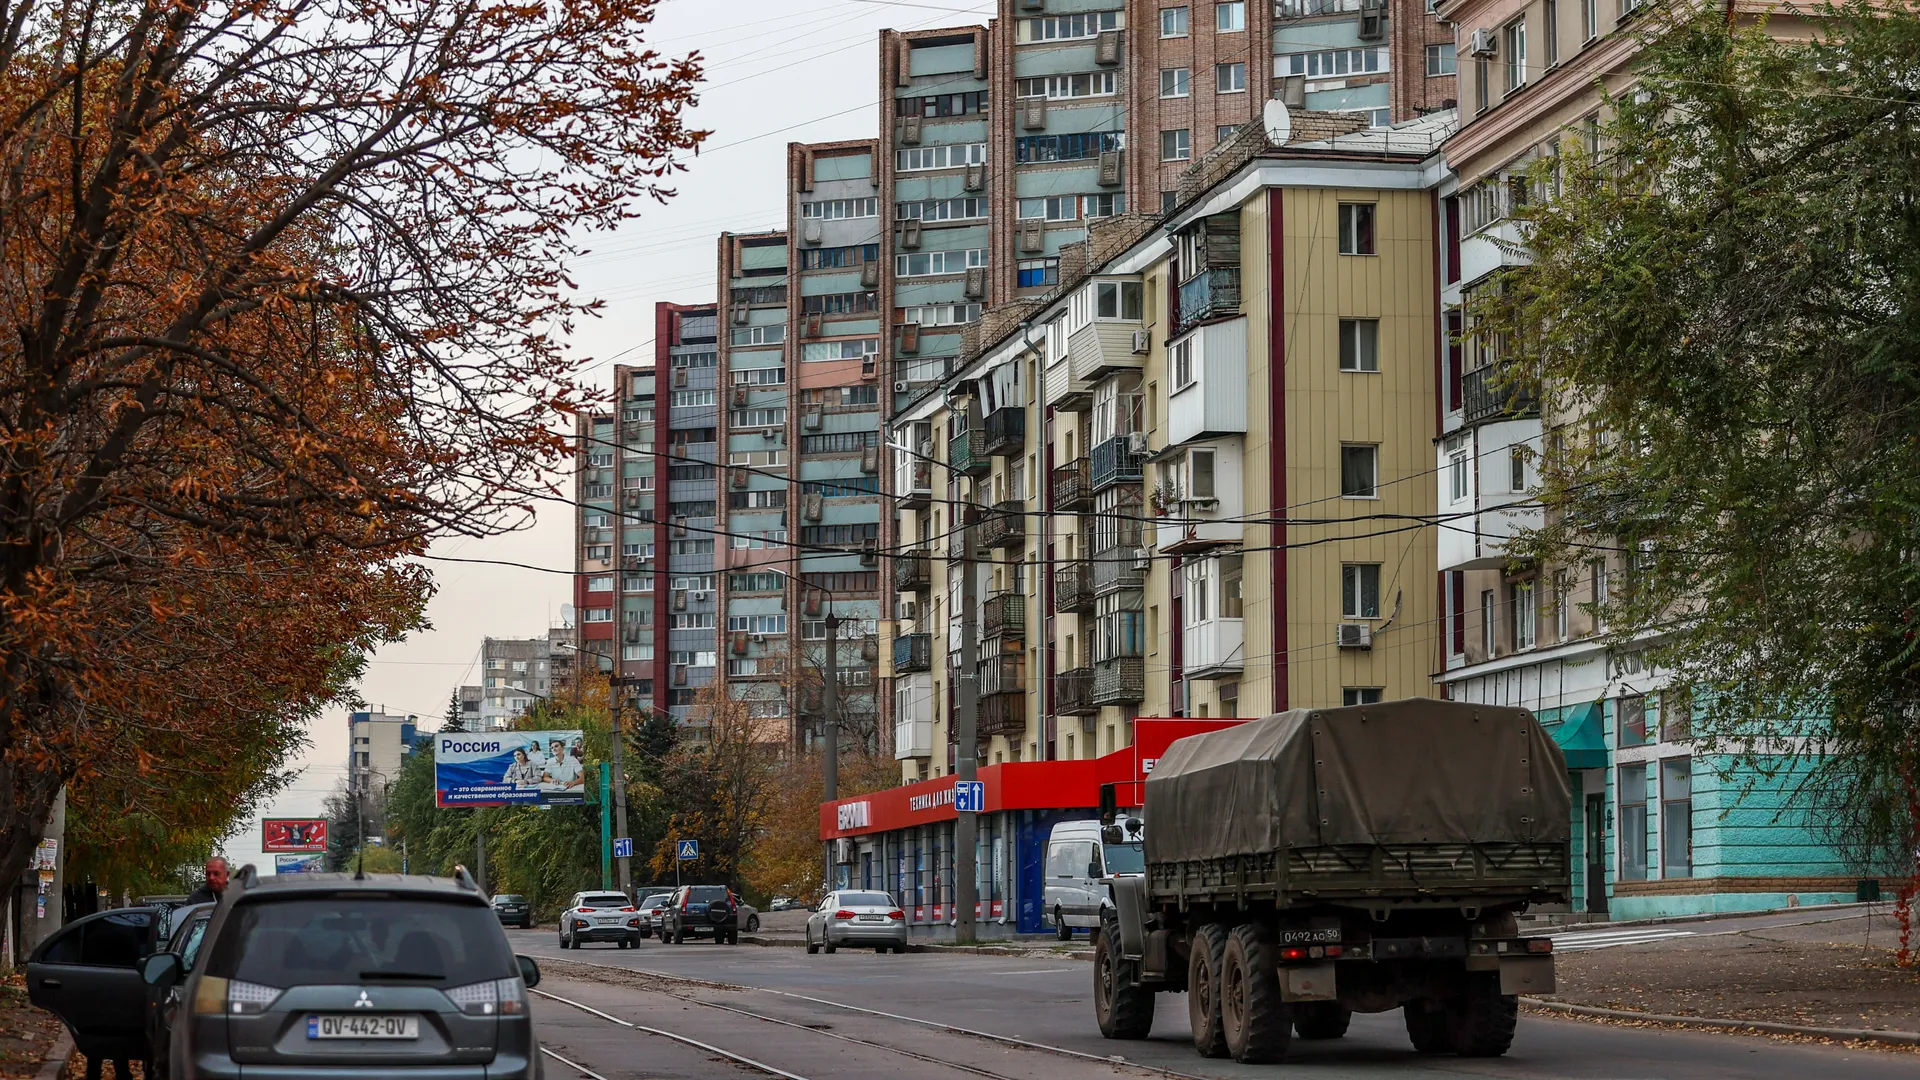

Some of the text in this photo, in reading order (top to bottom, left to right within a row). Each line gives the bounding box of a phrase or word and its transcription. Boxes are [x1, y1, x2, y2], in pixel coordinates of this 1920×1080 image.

[442, 740, 500, 753] Россия
[910, 793, 931, 811] ТЕХНИКА
[933, 791, 943, 809] ДЛЯ
[1284, 932, 1311, 942] 0492
[323, 1018, 406, 1035] QV-442-QV
